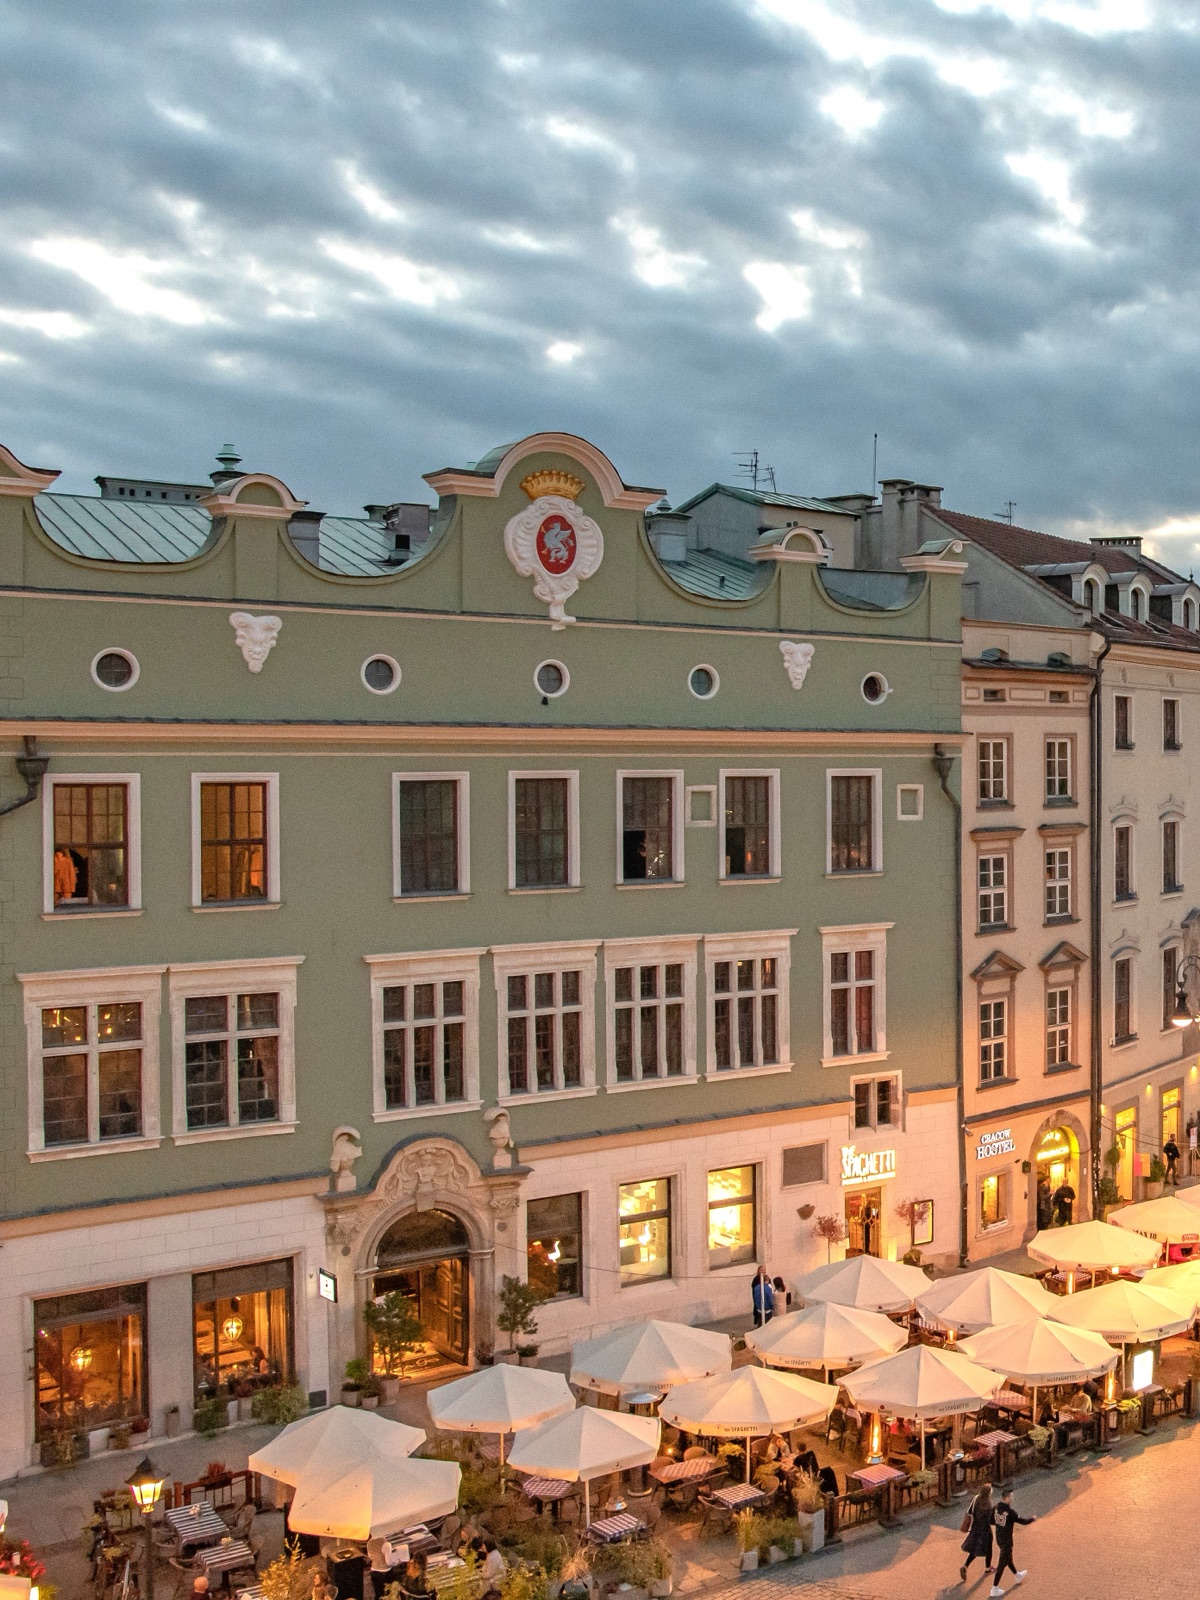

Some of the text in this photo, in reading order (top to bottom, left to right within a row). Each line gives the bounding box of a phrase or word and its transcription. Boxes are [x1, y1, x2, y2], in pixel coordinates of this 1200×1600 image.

[980, 1128, 1011, 1144] CRACOW
[976, 1138, 1016, 1160] HOSTEL
[841, 1149, 896, 1179] SPAGHETTI
